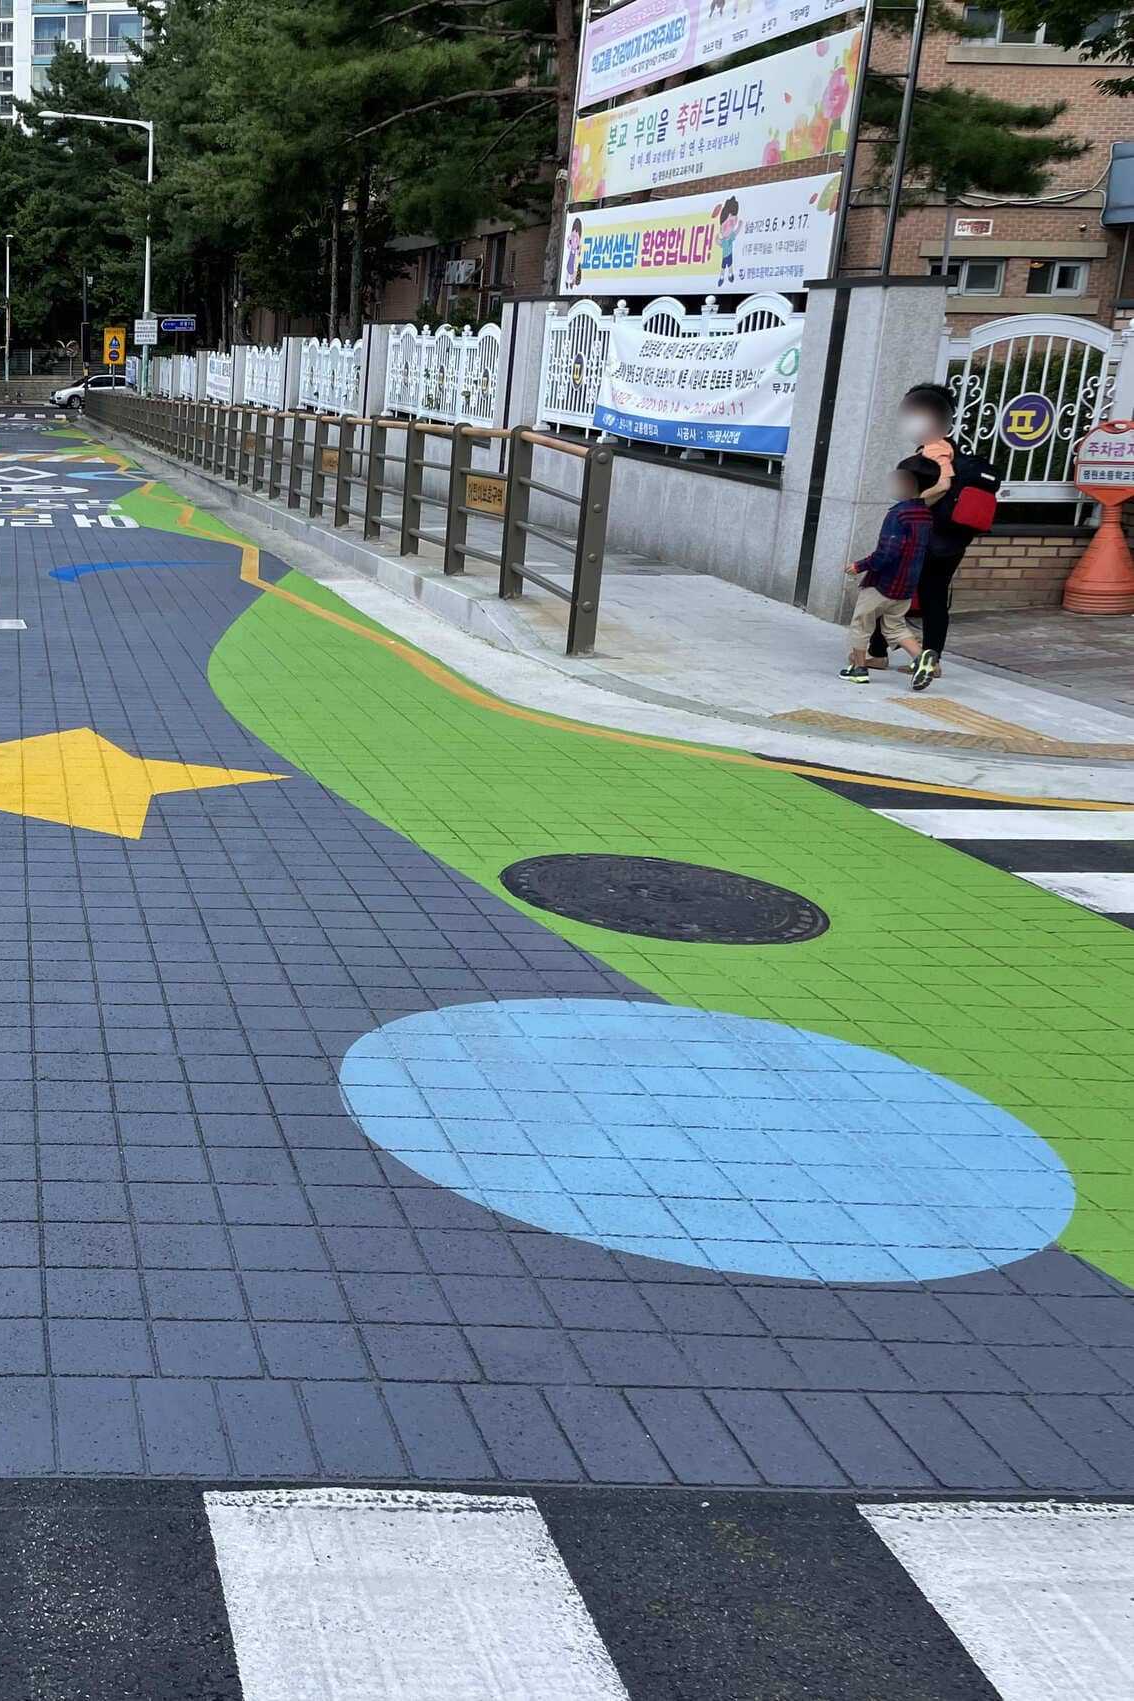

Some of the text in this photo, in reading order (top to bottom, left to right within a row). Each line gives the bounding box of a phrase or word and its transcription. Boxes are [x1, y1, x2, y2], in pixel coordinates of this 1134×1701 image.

[607, 123, 629, 155] 본교
[634, 108, 669, 148] 부임을
[676, 79, 765, 137] 축하드립니다.
[581, 224, 714, 270] 교생선생님! 환영합니다!
[676, 427, 697, 441] 시공사
